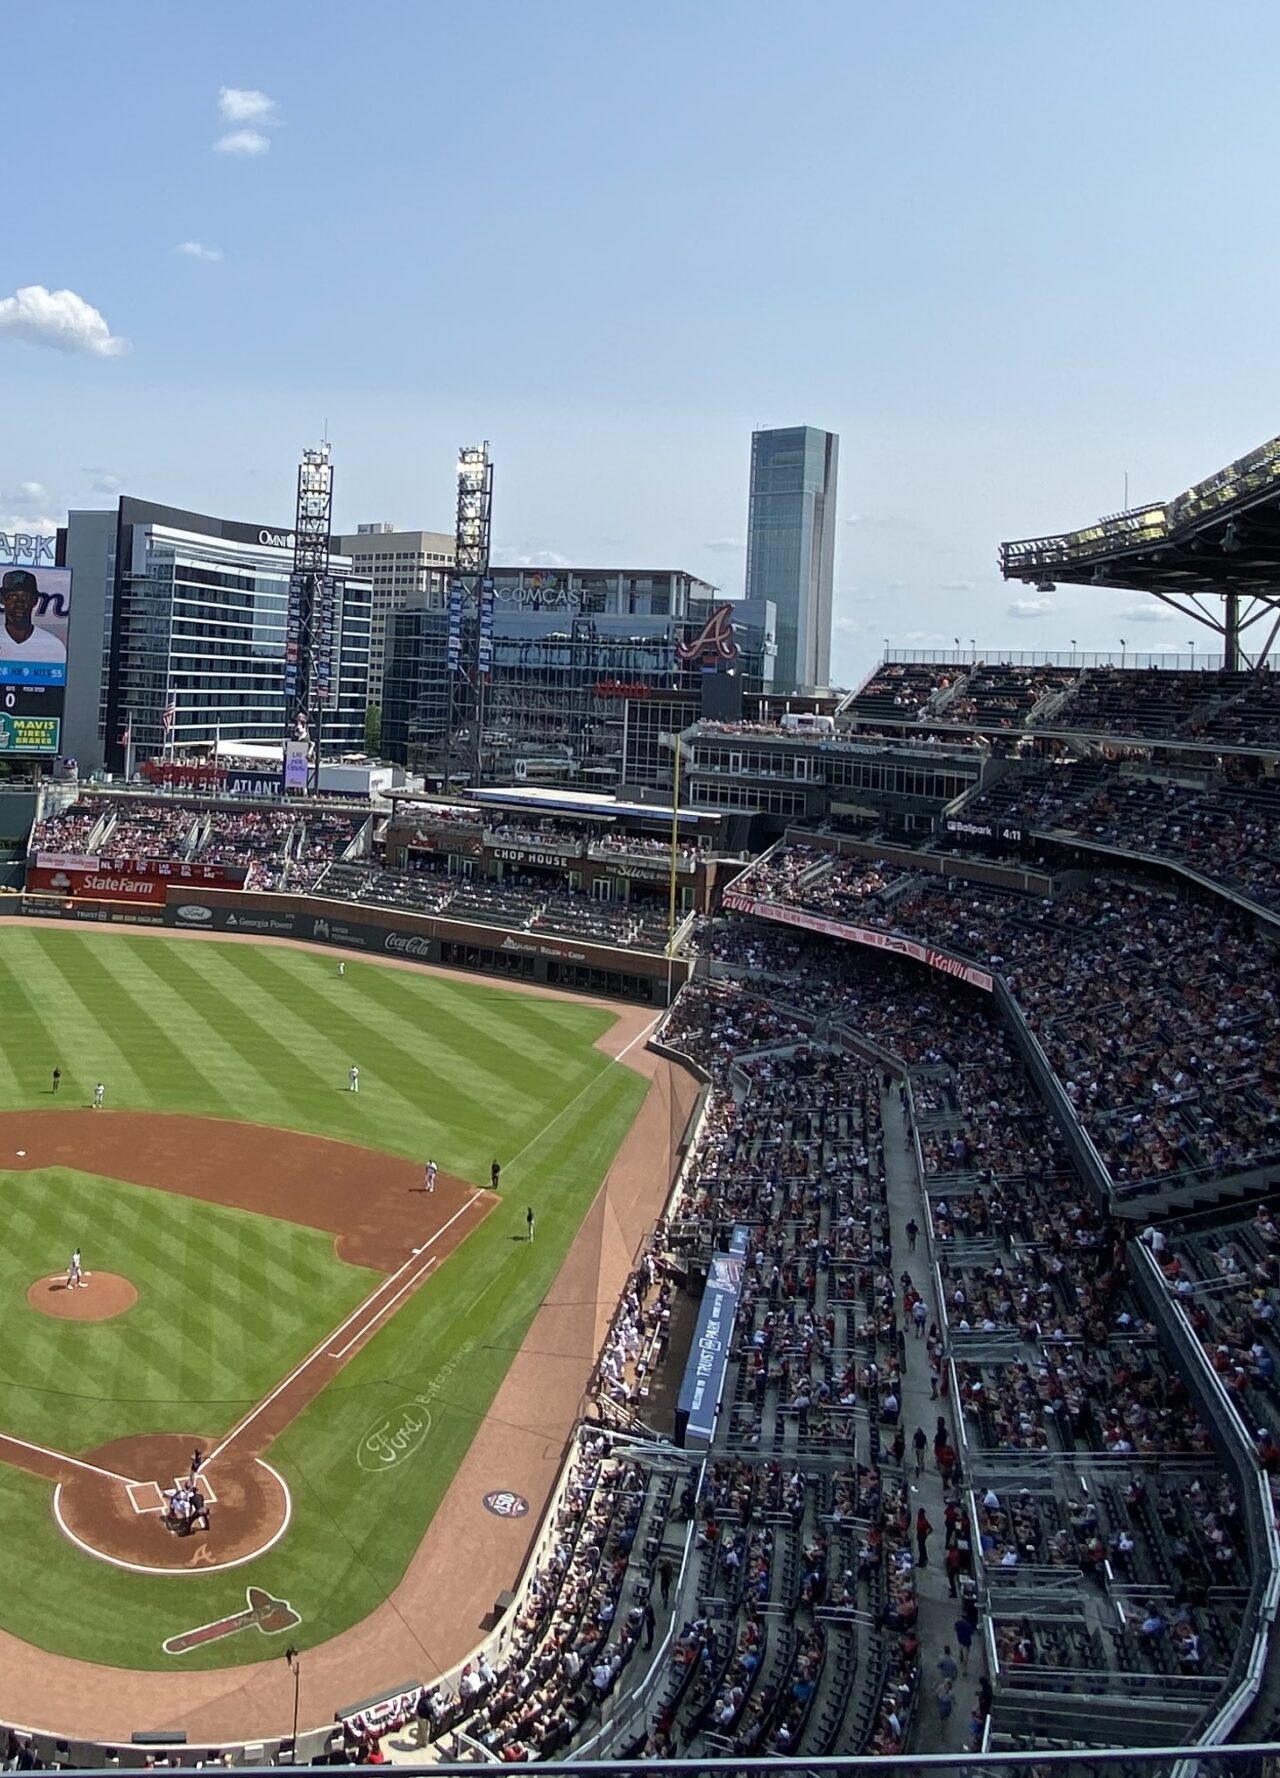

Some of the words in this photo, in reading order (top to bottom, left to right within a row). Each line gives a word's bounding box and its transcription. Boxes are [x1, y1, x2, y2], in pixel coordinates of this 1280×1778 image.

[497, 586, 589, 605] COMCAST
[6, 693, 15, 707] 0
[13, 720, 55, 730] MAVIS
[232, 779, 282, 796] ATLANT
[957, 821, 993, 837] Ballpark
[1002, 828, 1021, 841] 4:11
[101, 861, 112, 870] NL
[493, 847, 525, 861] CHOP
[528, 852, 568, 868] HOUSE
[238, 916, 269, 930] Georgia
[269, 919, 294, 930] Power
[697, 1348, 715, 1377] TRUIST
[706, 1319, 721, 1341] PARK
[365, 1412, 423, 1462] Ford
